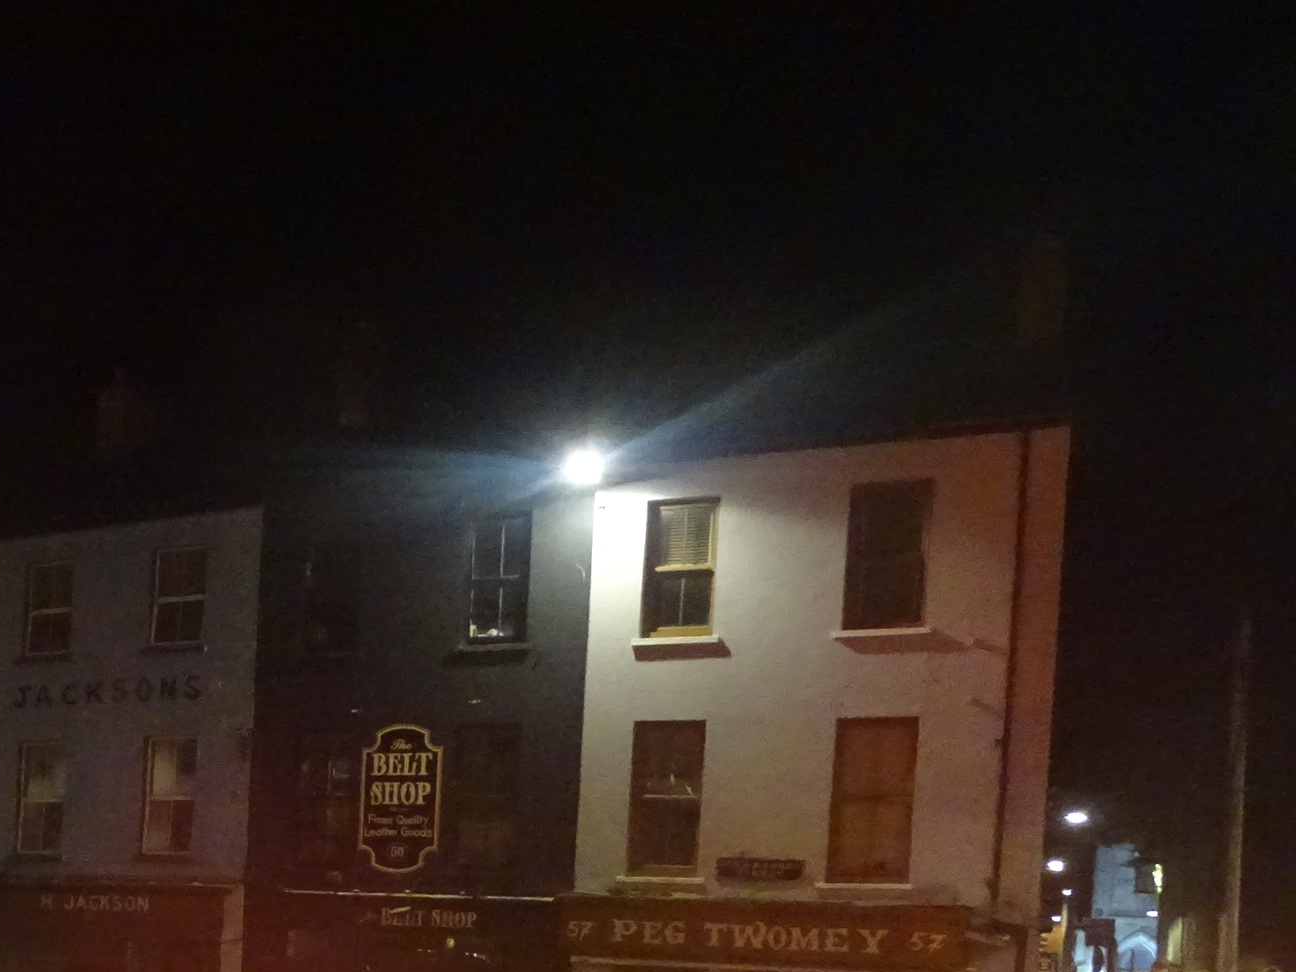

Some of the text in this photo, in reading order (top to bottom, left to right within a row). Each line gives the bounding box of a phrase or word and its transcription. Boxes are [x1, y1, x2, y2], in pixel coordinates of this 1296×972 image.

[14, 675, 203, 709] JACKSONS
[390, 738, 412, 750] The
[371, 752, 433, 776] BELT
[370, 781, 431, 806] SHOP
[401, 826, 433, 838] Goods
[63, 895, 149, 912] JACKSON
[431, 909, 477, 928] SHOP
[566, 918, 947, 954] 57 PEG TWOMEY 57
